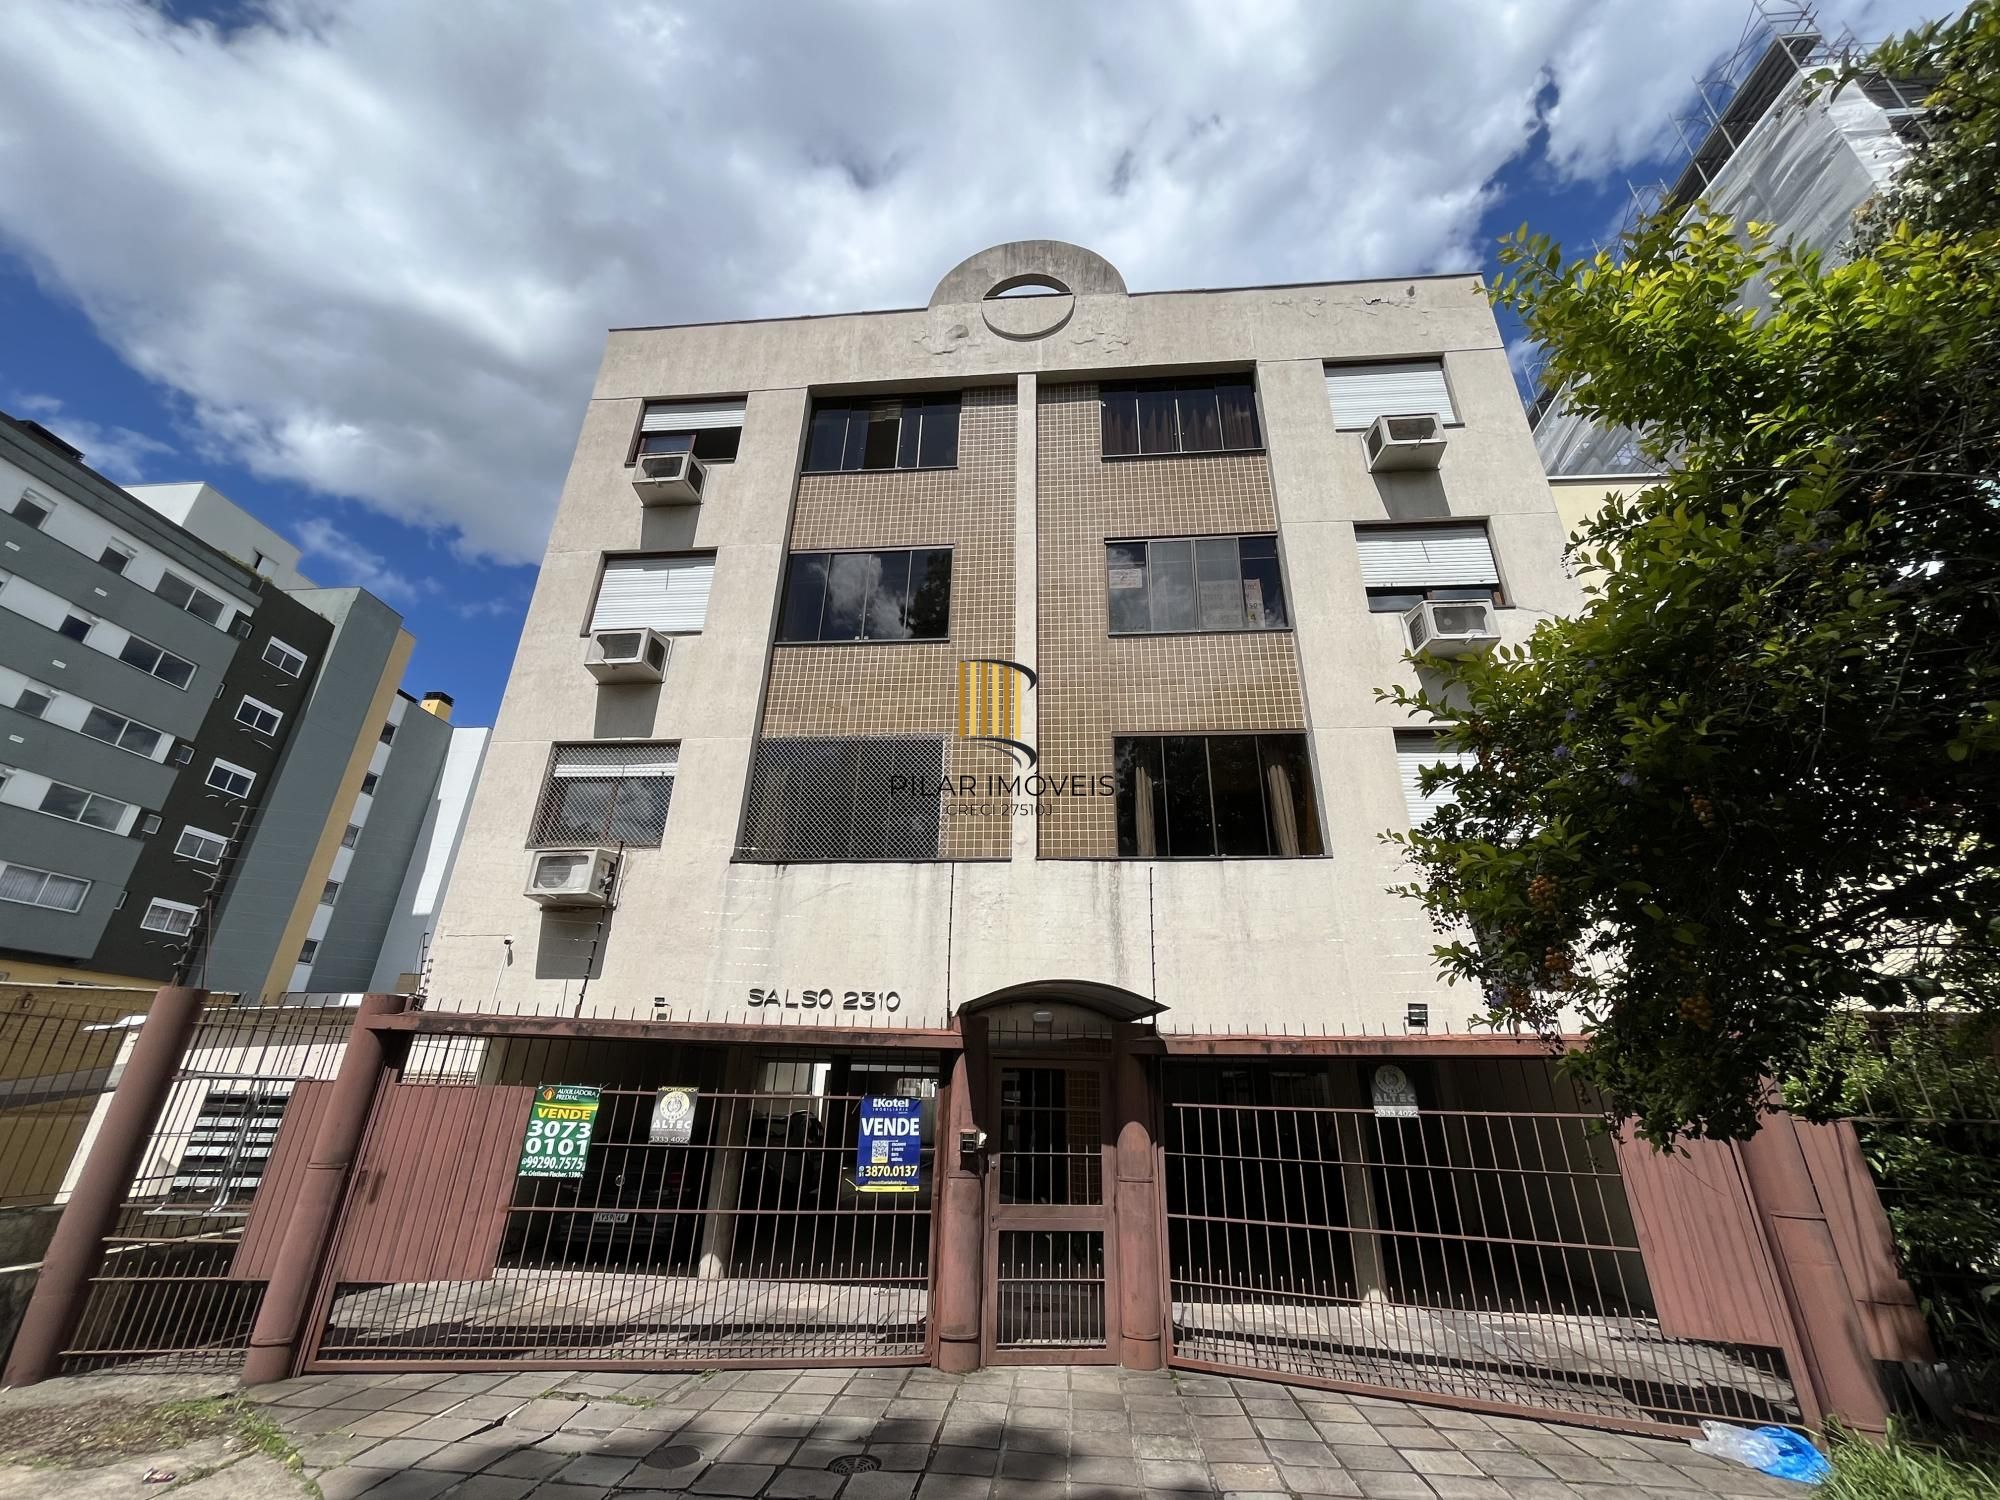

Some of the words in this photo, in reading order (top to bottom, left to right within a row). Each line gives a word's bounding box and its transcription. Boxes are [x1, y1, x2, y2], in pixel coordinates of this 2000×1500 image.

[747, 988, 834, 1010] SALSO
[842, 991, 901, 1013] 2310
[558, 1088, 596, 1096] AUXILIADORA
[1374, 1093, 1416, 1103] ALTEC
[873, 1098, 909, 1108] Kotel
[538, 1108, 592, 1120] VENDE
[527, 1120, 591, 1138] 3073
[652, 1119, 691, 1129] ALTEC
[861, 1117, 920, 1136] VENDE
[525, 1137, 588, 1156] 0101
[526, 1156, 584, 1170] 99290.7575
[865, 1165, 918, 1178] 3870.0137
